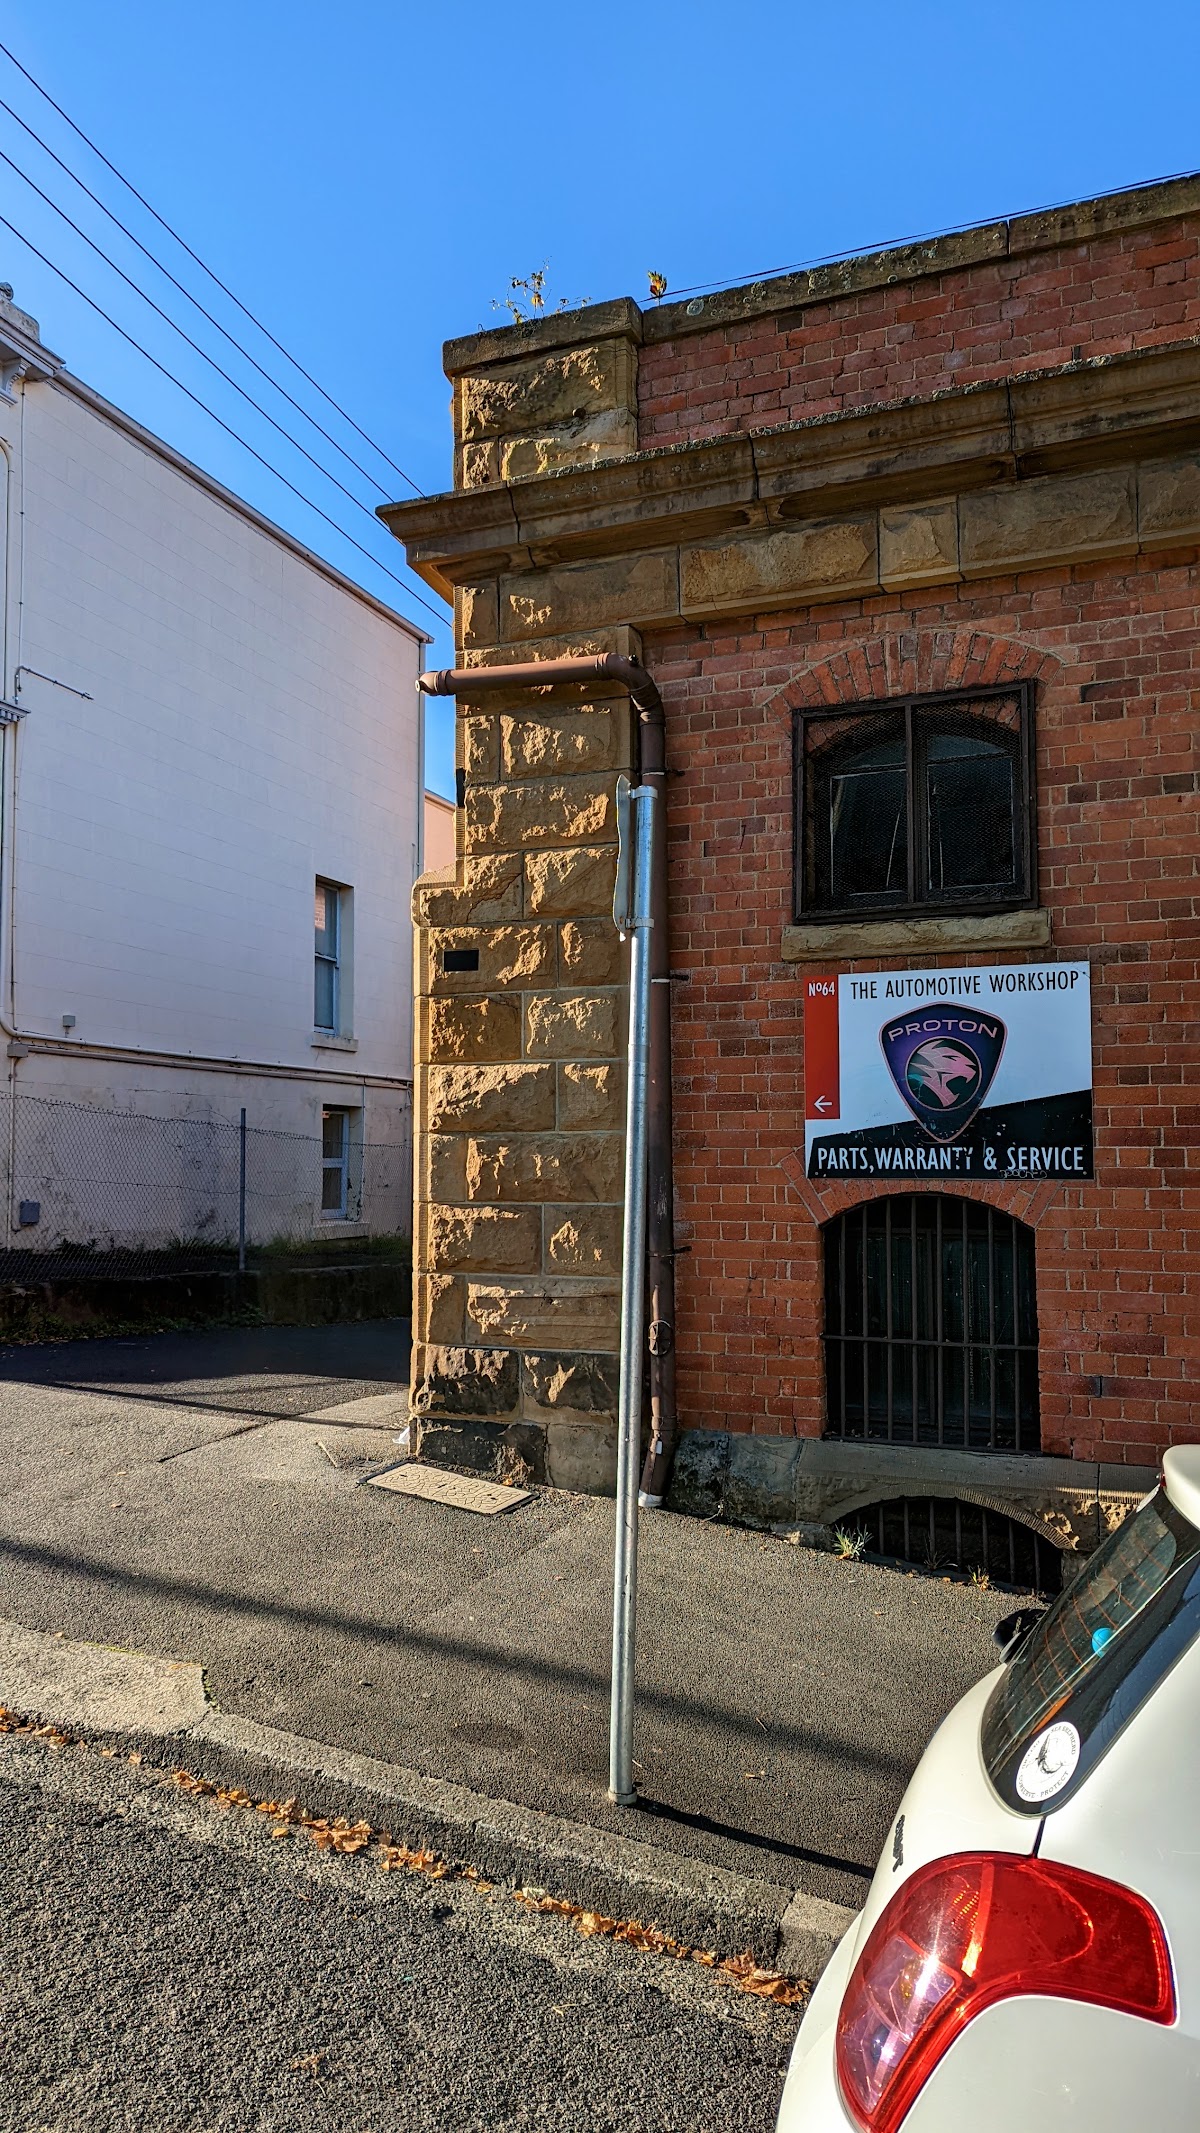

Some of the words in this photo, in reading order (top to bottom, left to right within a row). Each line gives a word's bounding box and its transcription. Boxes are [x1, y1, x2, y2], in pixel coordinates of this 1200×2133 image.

[850, 981, 878, 1000] THE
[885, 975, 982, 998] AUTOMOTIVE
[988, 970, 1079, 993] WORKSHOP
[887, 1019, 998, 1042] PROTON
[983, 1146, 998, 1170] &
[1006, 1146, 1084, 1171] SERVICE
[1040, 1770, 1069, 1798] PROTECT
